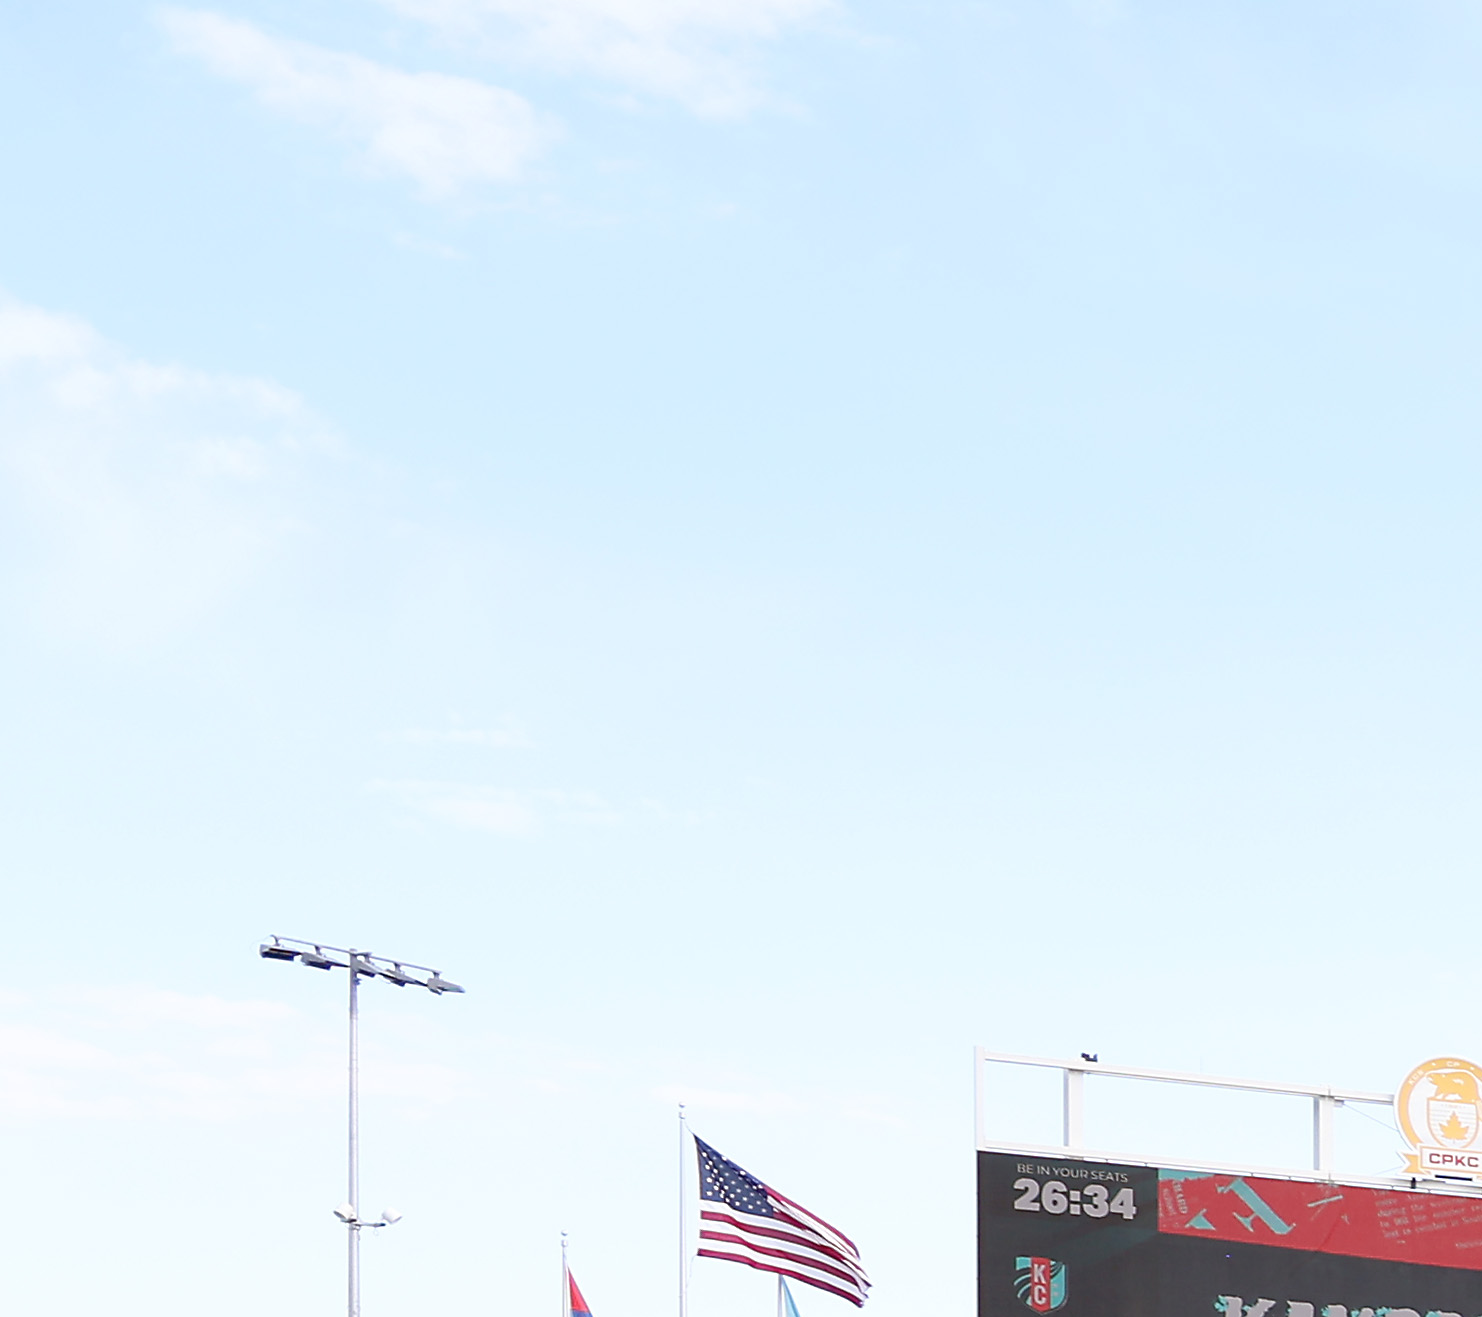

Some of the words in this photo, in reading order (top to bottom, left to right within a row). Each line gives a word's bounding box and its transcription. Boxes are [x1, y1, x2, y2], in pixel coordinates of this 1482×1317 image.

[1017, 1163, 1033, 1174] BE
[1037, 1165, 1050, 1176] IN
[1052, 1167, 1089, 1180] YOUR
[1091, 1170, 1129, 1183] SEATS
[1429, 1153, 1479, 1168] CPKC
[1013, 1178, 1137, 1220] 26:34
[1033, 1263, 1047, 1305] KC
